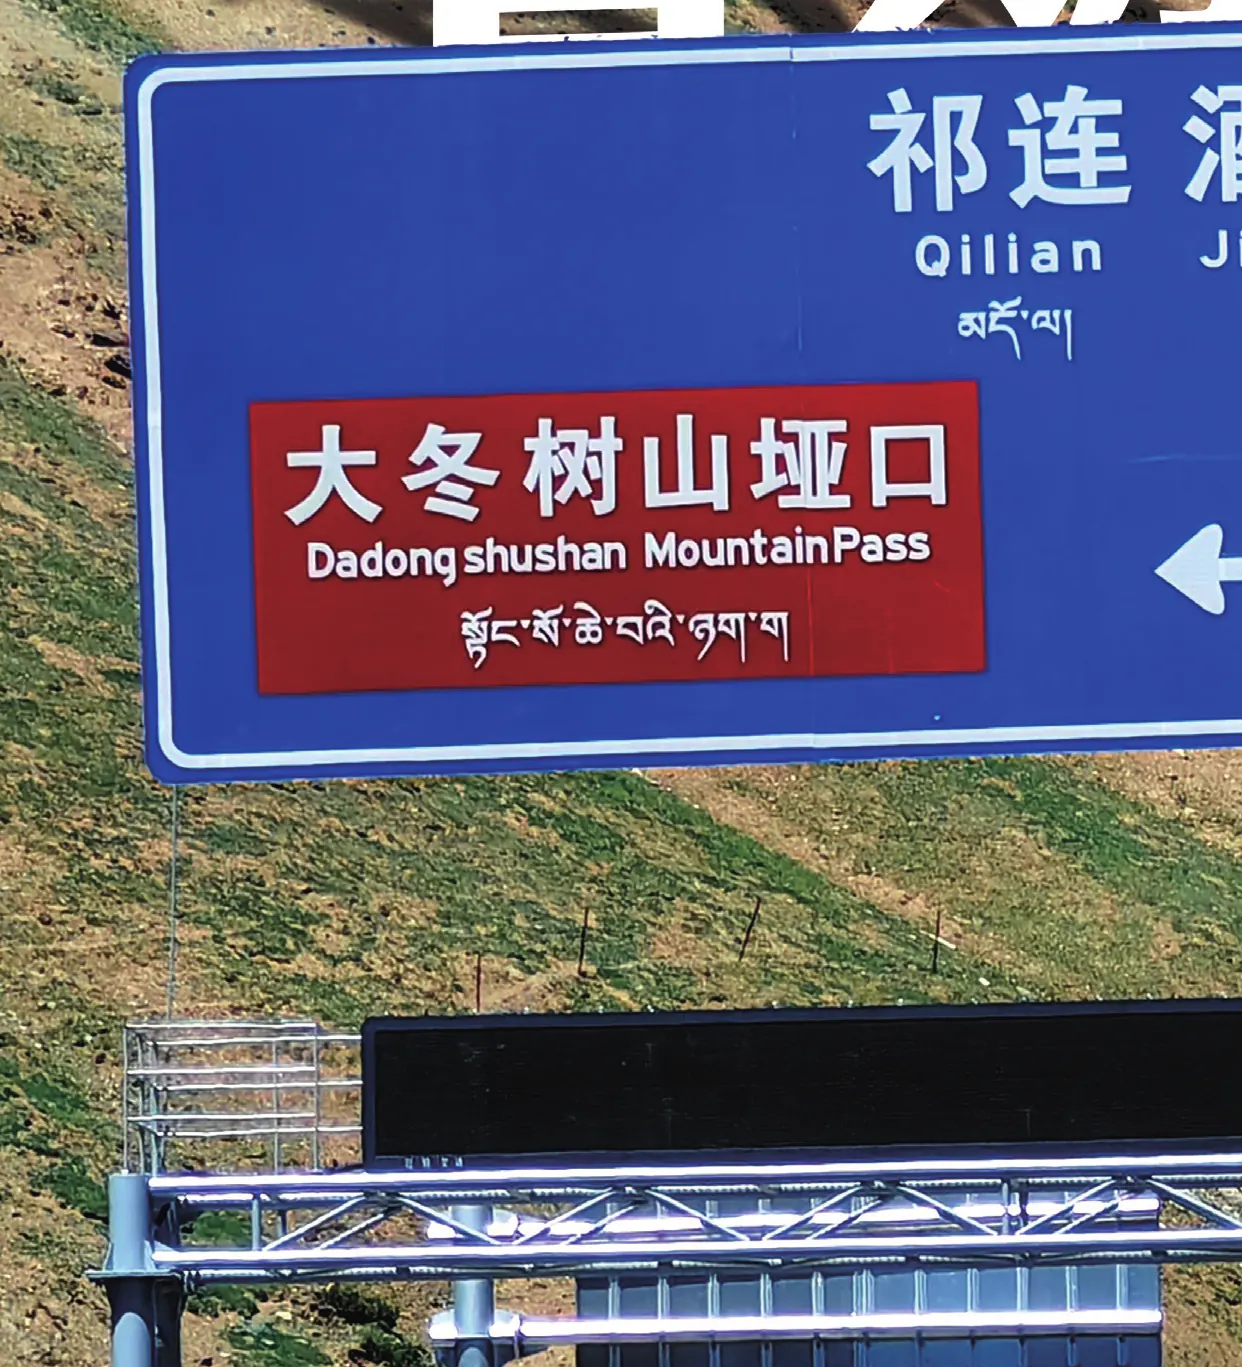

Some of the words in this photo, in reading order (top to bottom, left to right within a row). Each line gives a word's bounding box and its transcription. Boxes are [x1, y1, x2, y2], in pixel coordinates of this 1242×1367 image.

[867, 85, 1132, 212] 祁连
[915, 233, 1101, 277] Qilian
[284, 413, 948, 527] 大冬树山垭口
